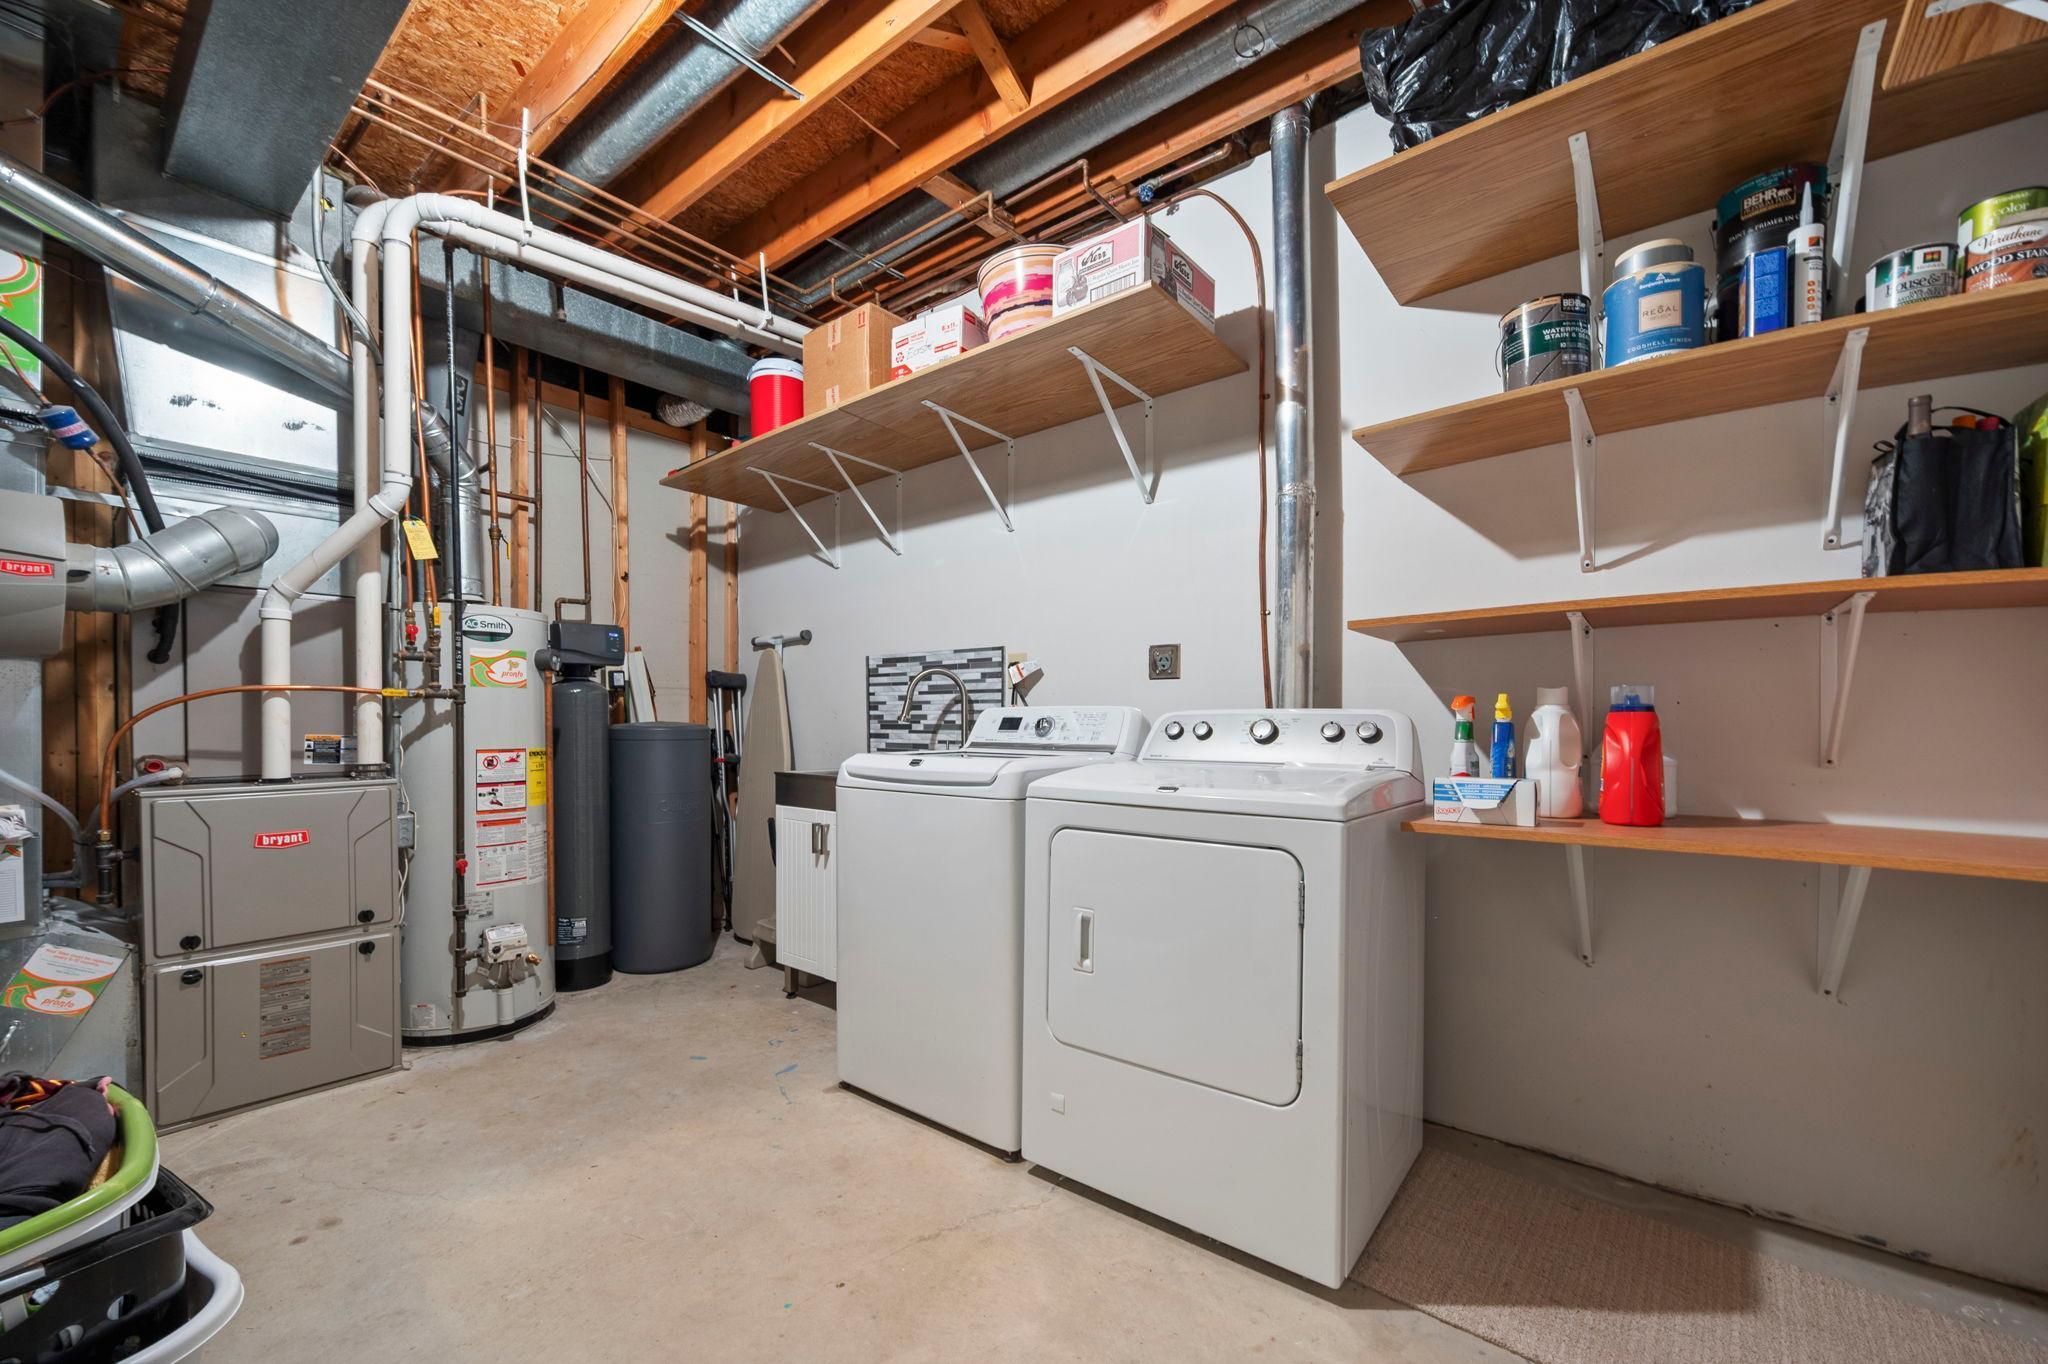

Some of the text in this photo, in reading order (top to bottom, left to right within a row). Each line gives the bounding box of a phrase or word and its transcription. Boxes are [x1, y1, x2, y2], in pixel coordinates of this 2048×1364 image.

[1743, 187, 1777, 209] BEHR
[1754, 216, 1783, 231] PRIMER
[1081, 246, 1107, 267] Kerr
[1970, 246, 2048, 275] WOOD STAIN
[1562, 298, 1580, 307] BEHR
[1642, 304, 1679, 317] REGAL
[1544, 332, 1569, 341] STAIN
[6, 562, 46, 573] bryant
[479, 620, 507, 630] Smith
[501, 670, 524, 678] pronto
[262, 832, 303, 845] bryant
[40, 998, 75, 1008] pronto
